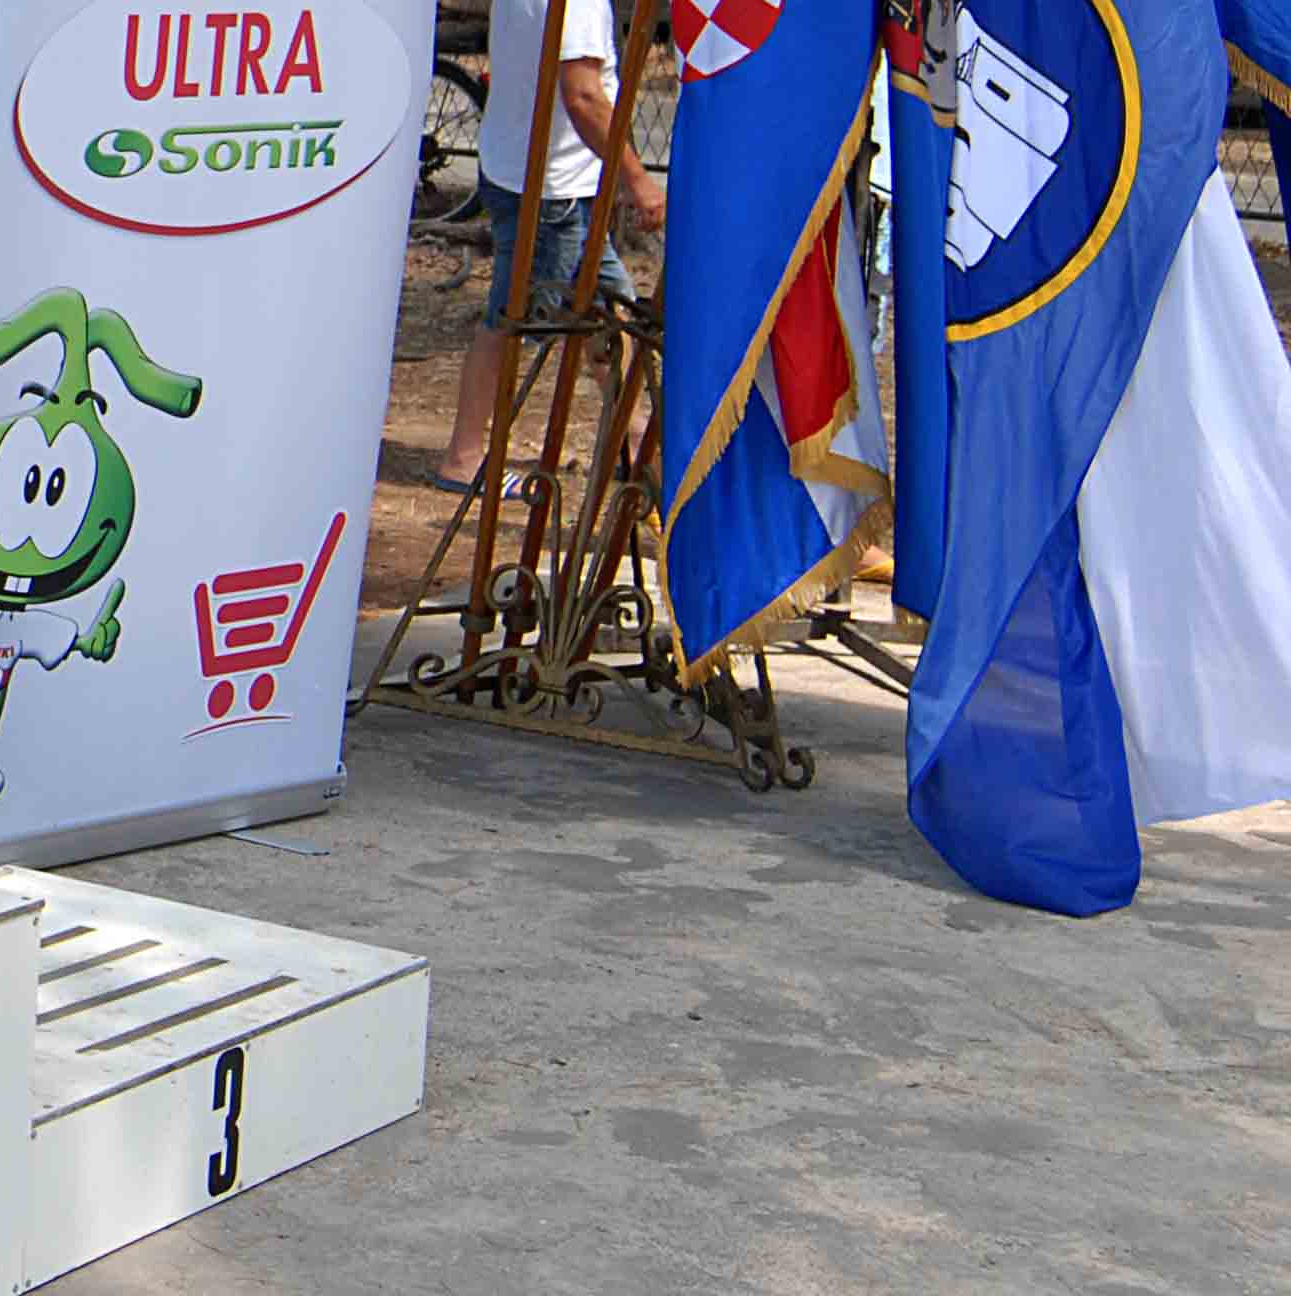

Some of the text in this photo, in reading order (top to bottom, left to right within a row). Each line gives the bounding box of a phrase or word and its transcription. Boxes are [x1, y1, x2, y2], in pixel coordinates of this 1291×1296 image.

[124, 10, 324, 102] ULTRA
[159, 120, 344, 175] Sonik
[207, 1046, 247, 1200] 3
